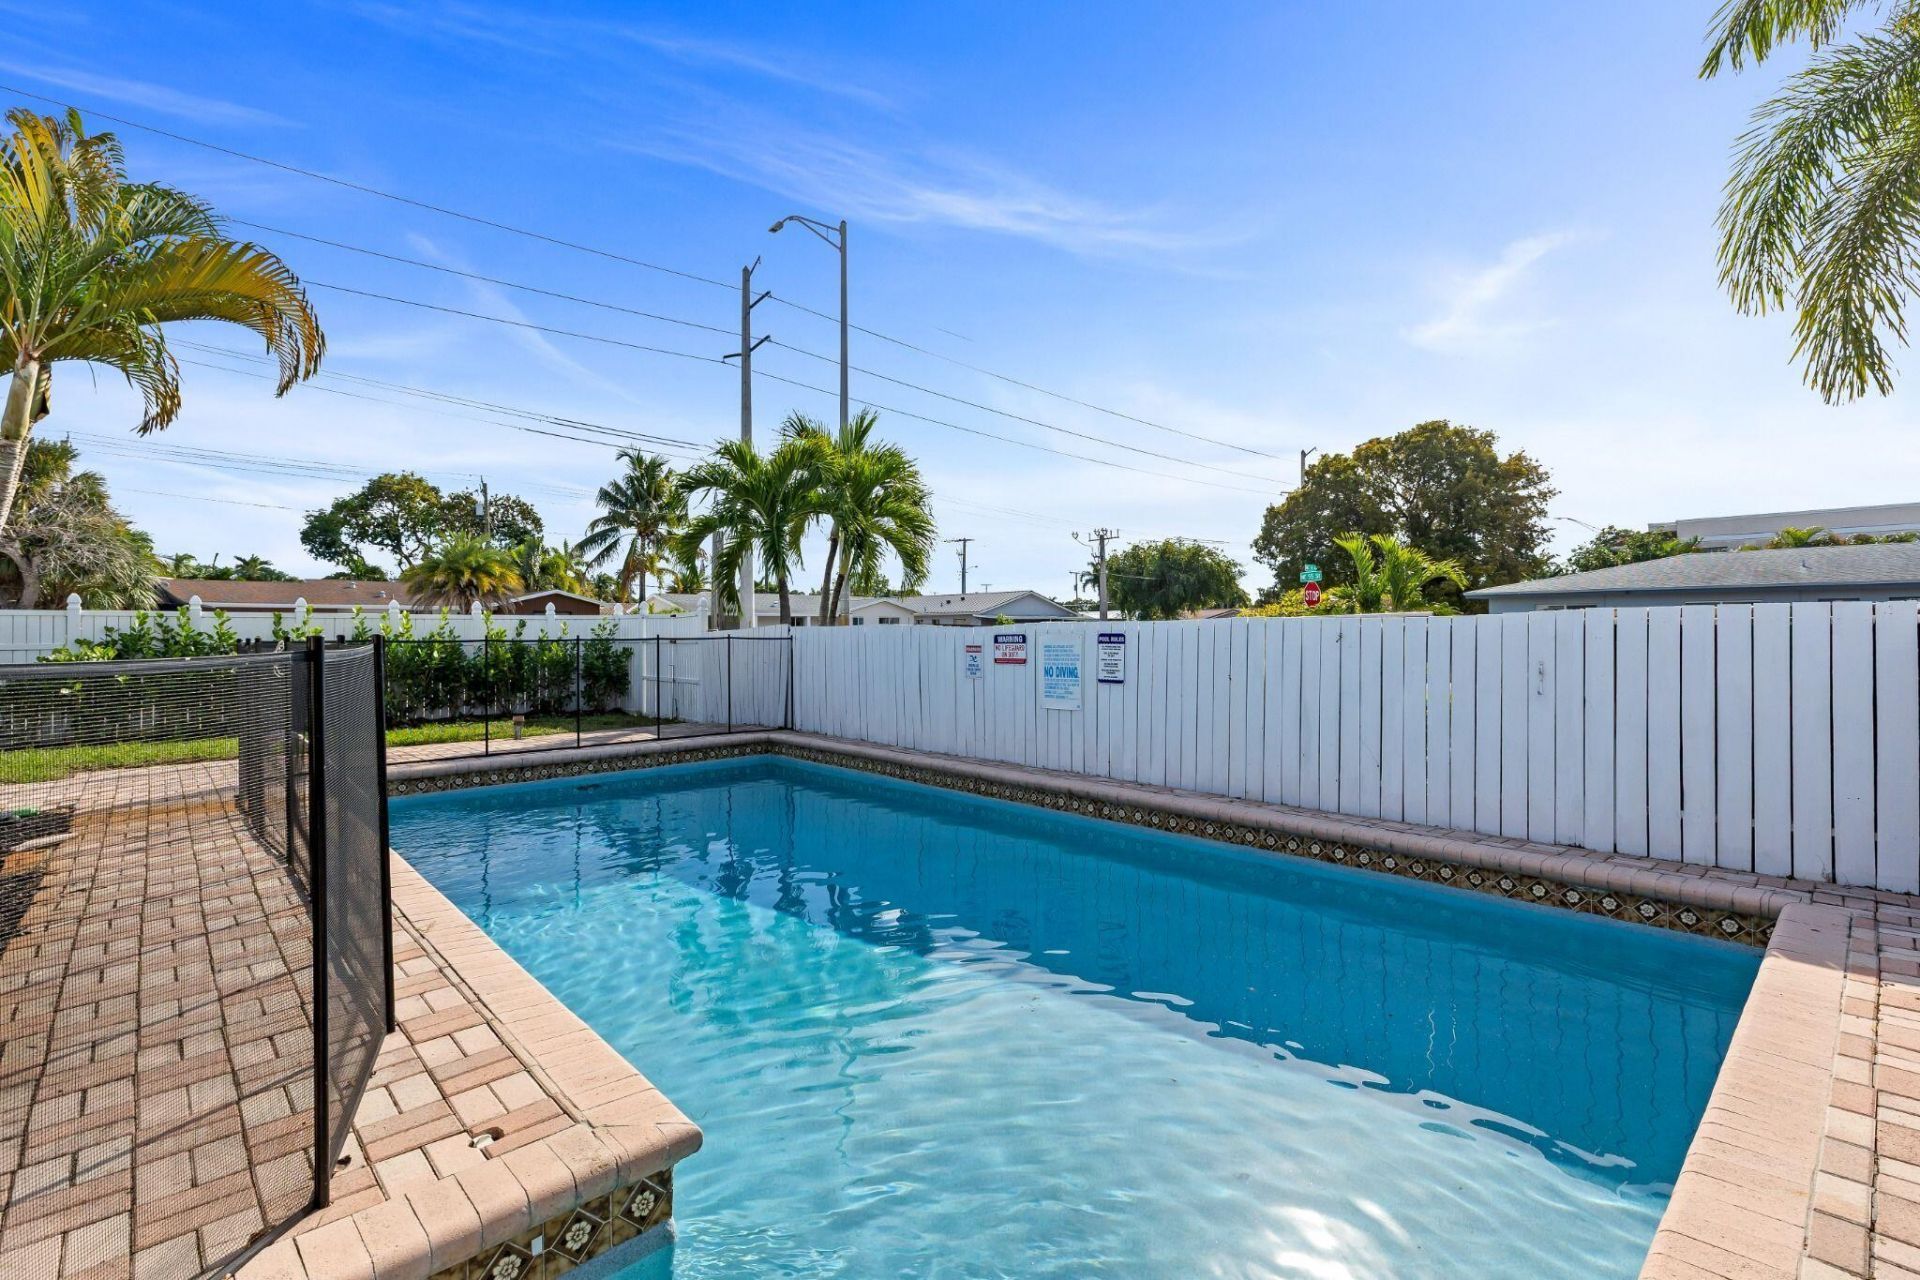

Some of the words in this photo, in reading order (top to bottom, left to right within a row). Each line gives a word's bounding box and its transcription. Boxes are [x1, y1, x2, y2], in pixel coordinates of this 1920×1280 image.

[1306, 590, 1319, 601] STOP
[997, 635, 1023, 643] WARNING
[1044, 666, 1054, 678] NO
